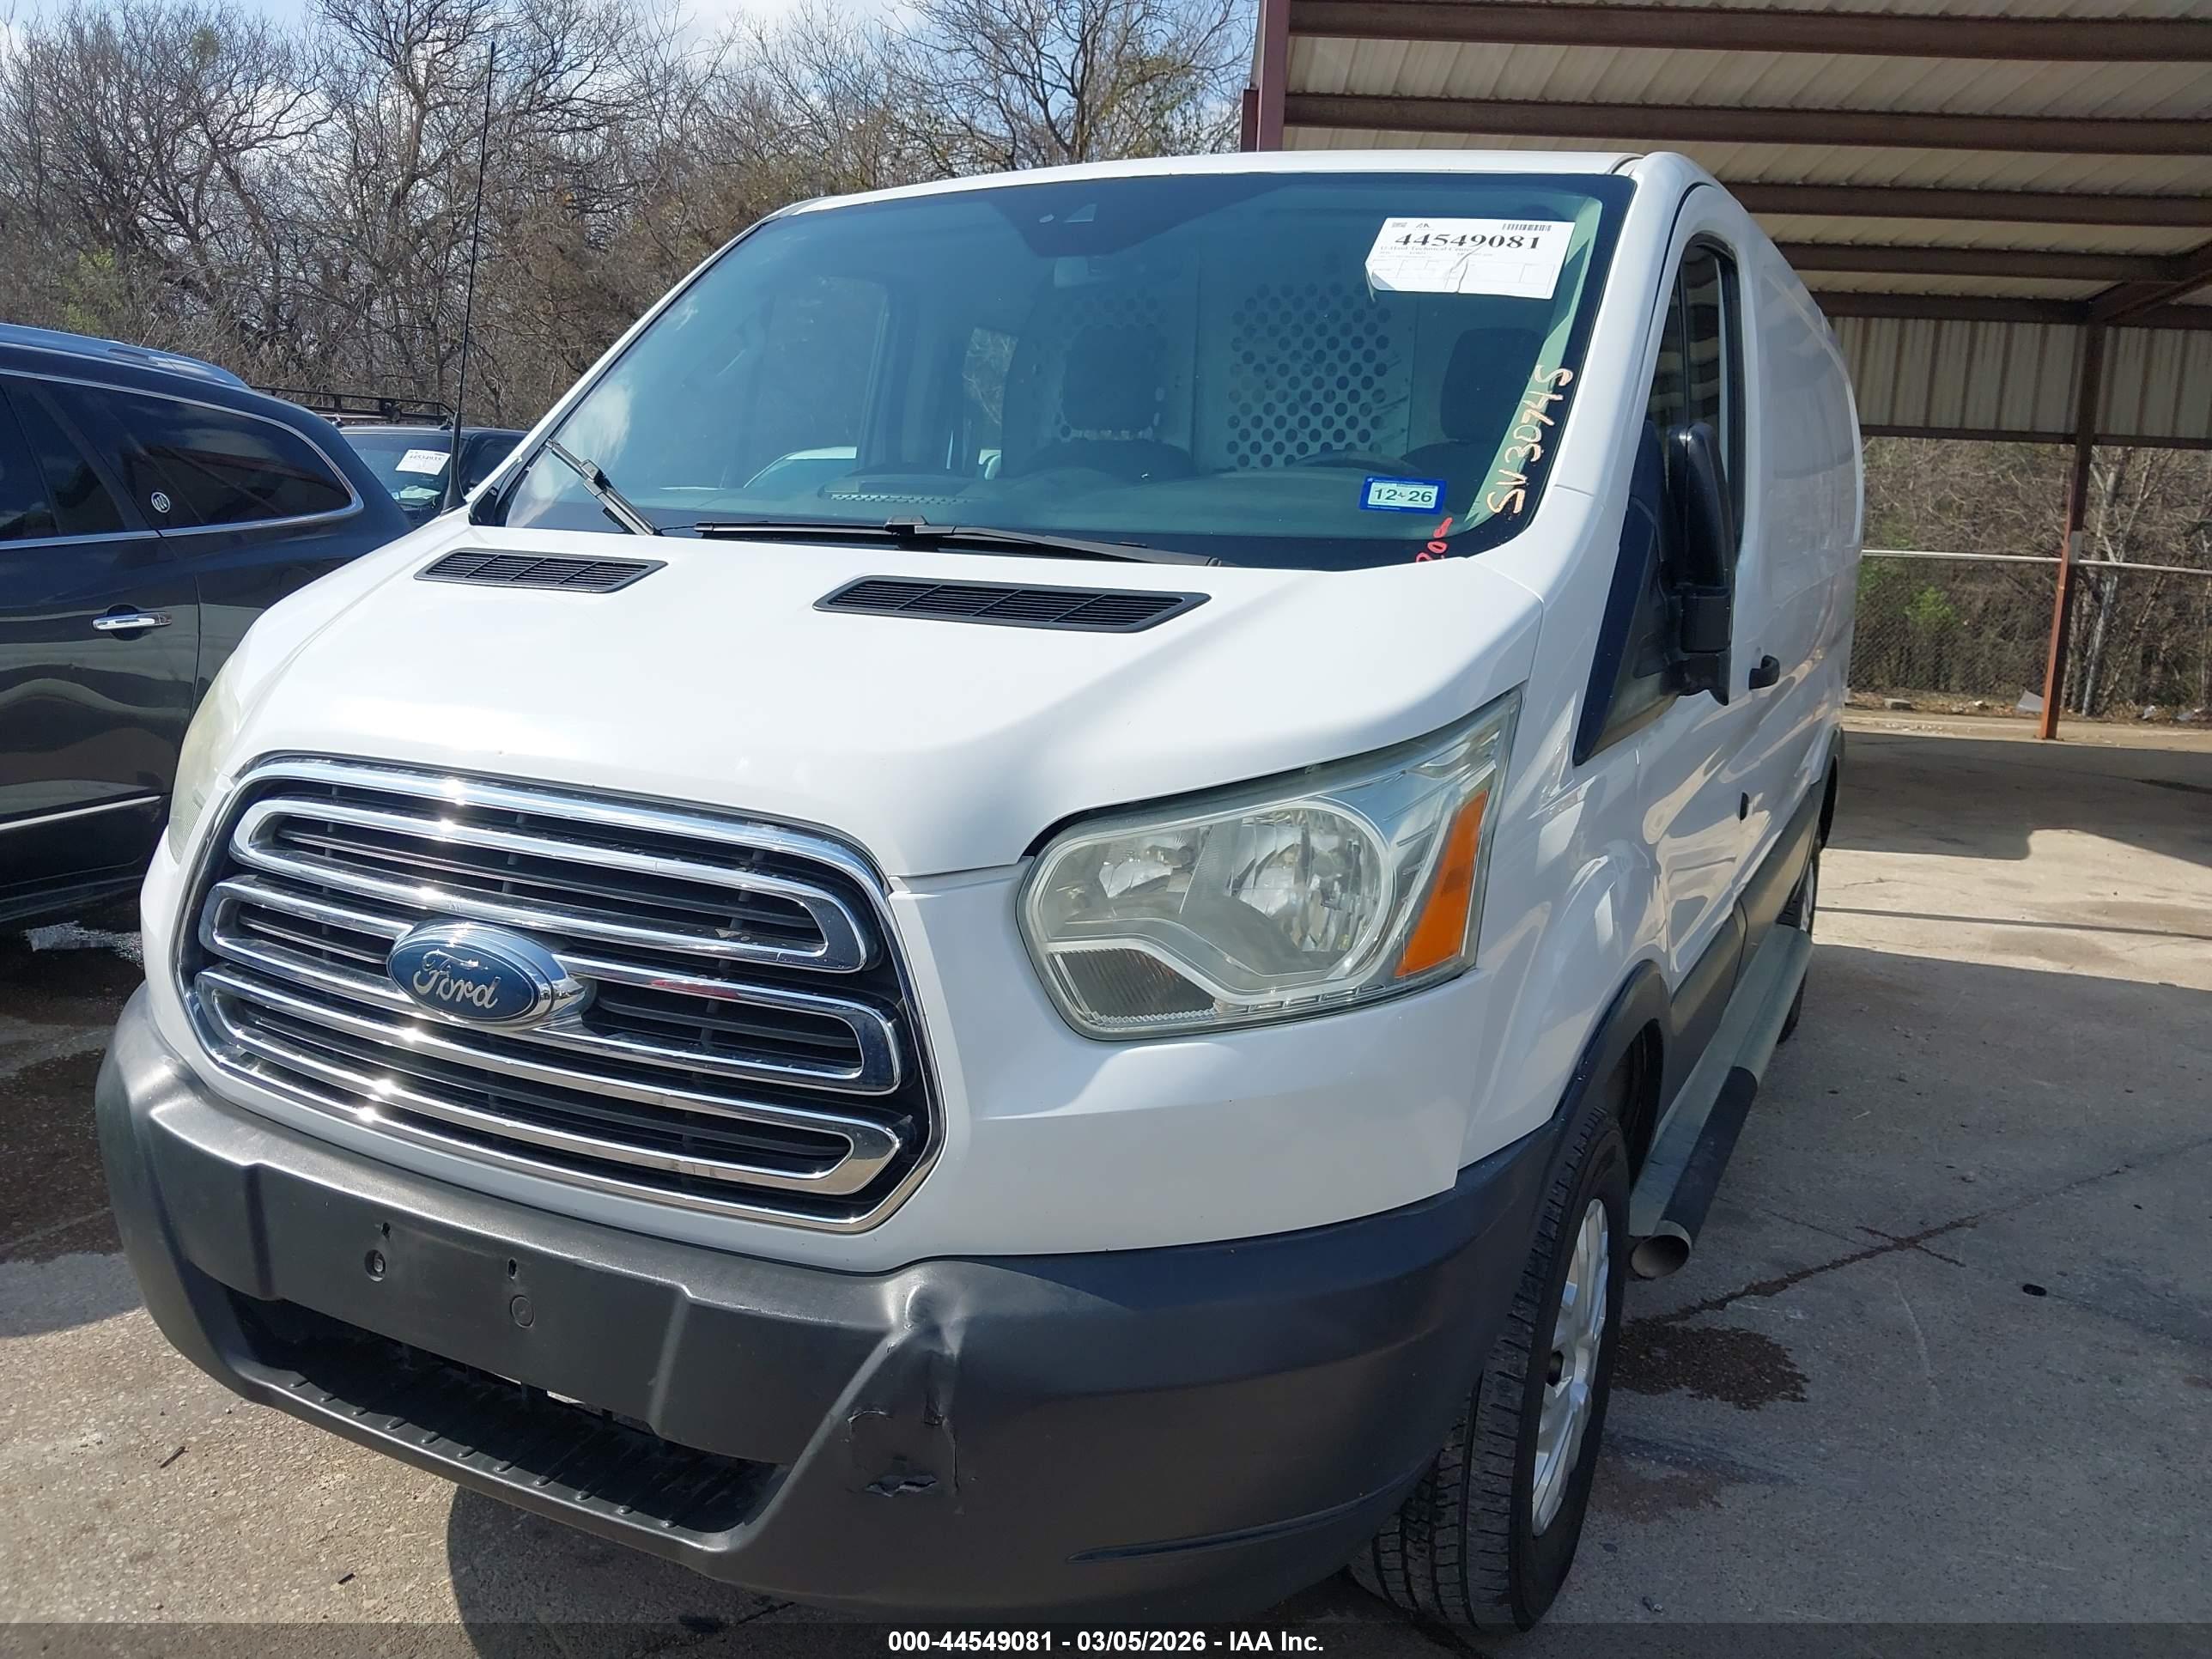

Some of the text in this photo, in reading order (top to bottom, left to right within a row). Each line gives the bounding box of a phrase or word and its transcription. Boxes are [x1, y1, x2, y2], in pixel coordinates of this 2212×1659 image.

[1395, 233, 1540, 250] 44549081
[1375, 489, 1432, 502] 12 26
[412, 948, 501, 1009] Ford
